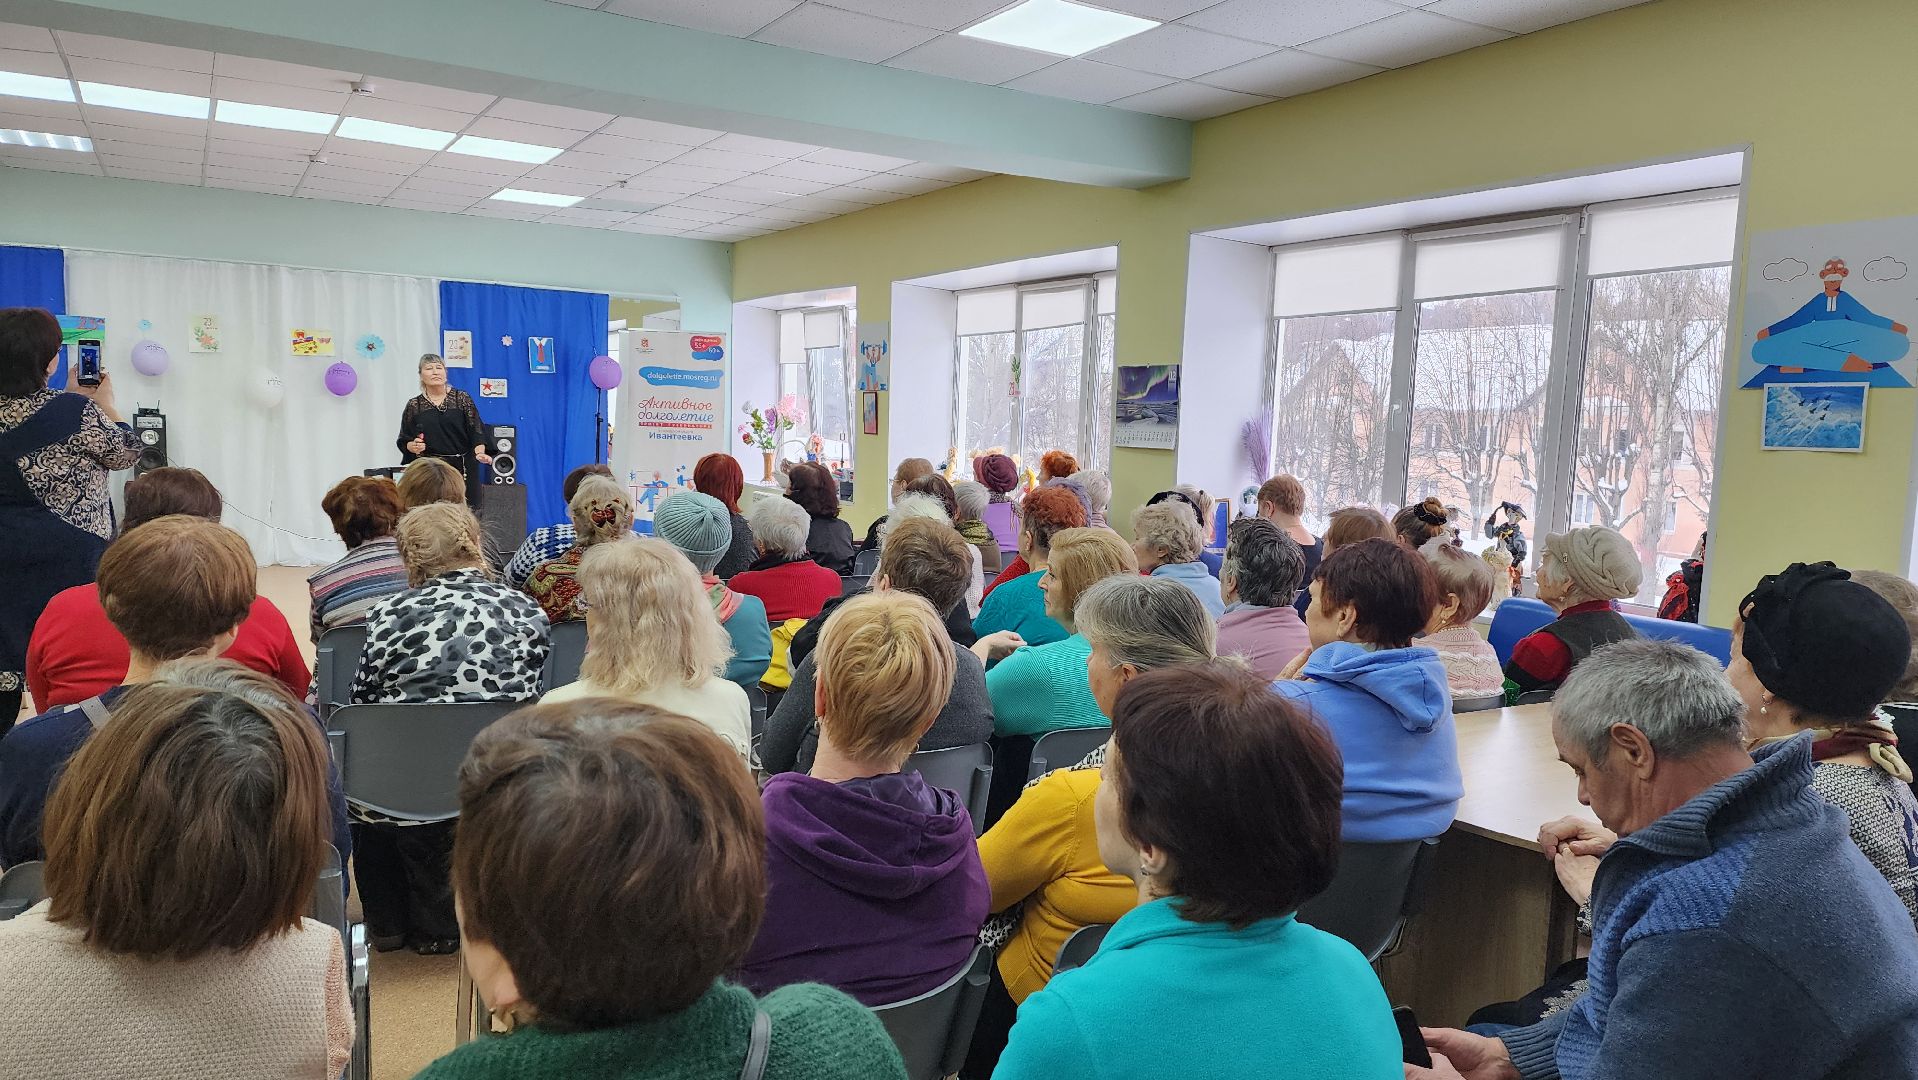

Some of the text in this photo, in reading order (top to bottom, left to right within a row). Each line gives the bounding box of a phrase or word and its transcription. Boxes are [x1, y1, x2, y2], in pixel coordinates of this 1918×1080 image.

[647, 372, 717, 382] dolgoletie.mosreg.ru
[638, 396, 712, 411] Активное
[638, 407, 714, 423] долголетие
[648, 431, 703, 441] Ивантеевка
